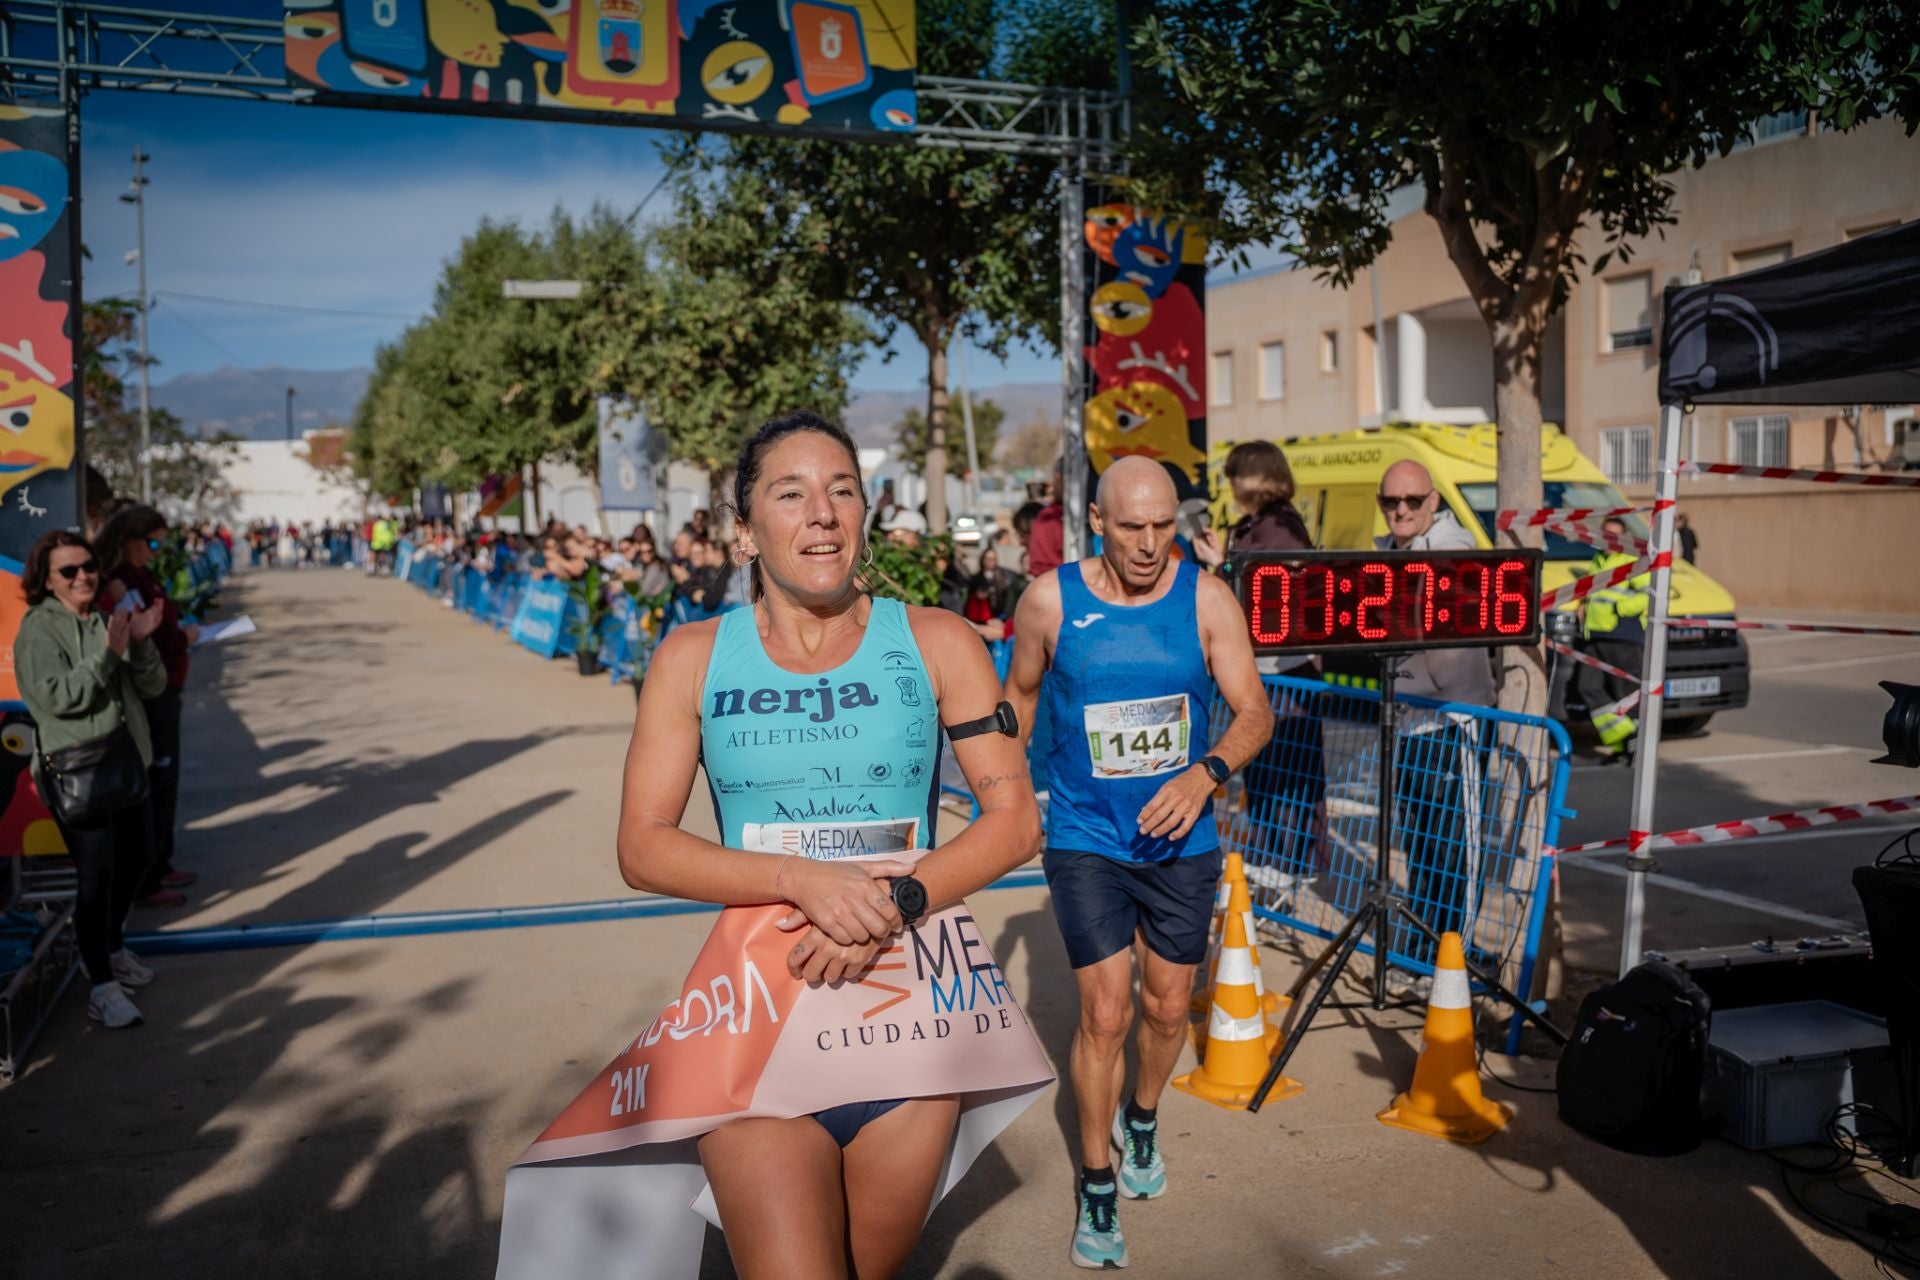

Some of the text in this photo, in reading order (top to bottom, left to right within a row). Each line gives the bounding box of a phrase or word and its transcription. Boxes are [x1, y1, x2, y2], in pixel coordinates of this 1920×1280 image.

[1322, 449, 1381, 466] AVANZADO
[1252, 562, 1527, 643] 01:27:16
[711, 677, 879, 723] nerja
[726, 723, 859, 749] ATLETISMO
[1109, 727, 1172, 757] 144
[773, 793, 881, 822] Andalucía
[801, 829, 865, 849] MEDIA
[910, 916, 991, 981] ME
[930, 963, 1017, 1014] MAR
[817, 1018, 951, 1051] CIUDAD
[975, 1009, 1012, 1040] DE
[610, 1064, 649, 1116] 21K
